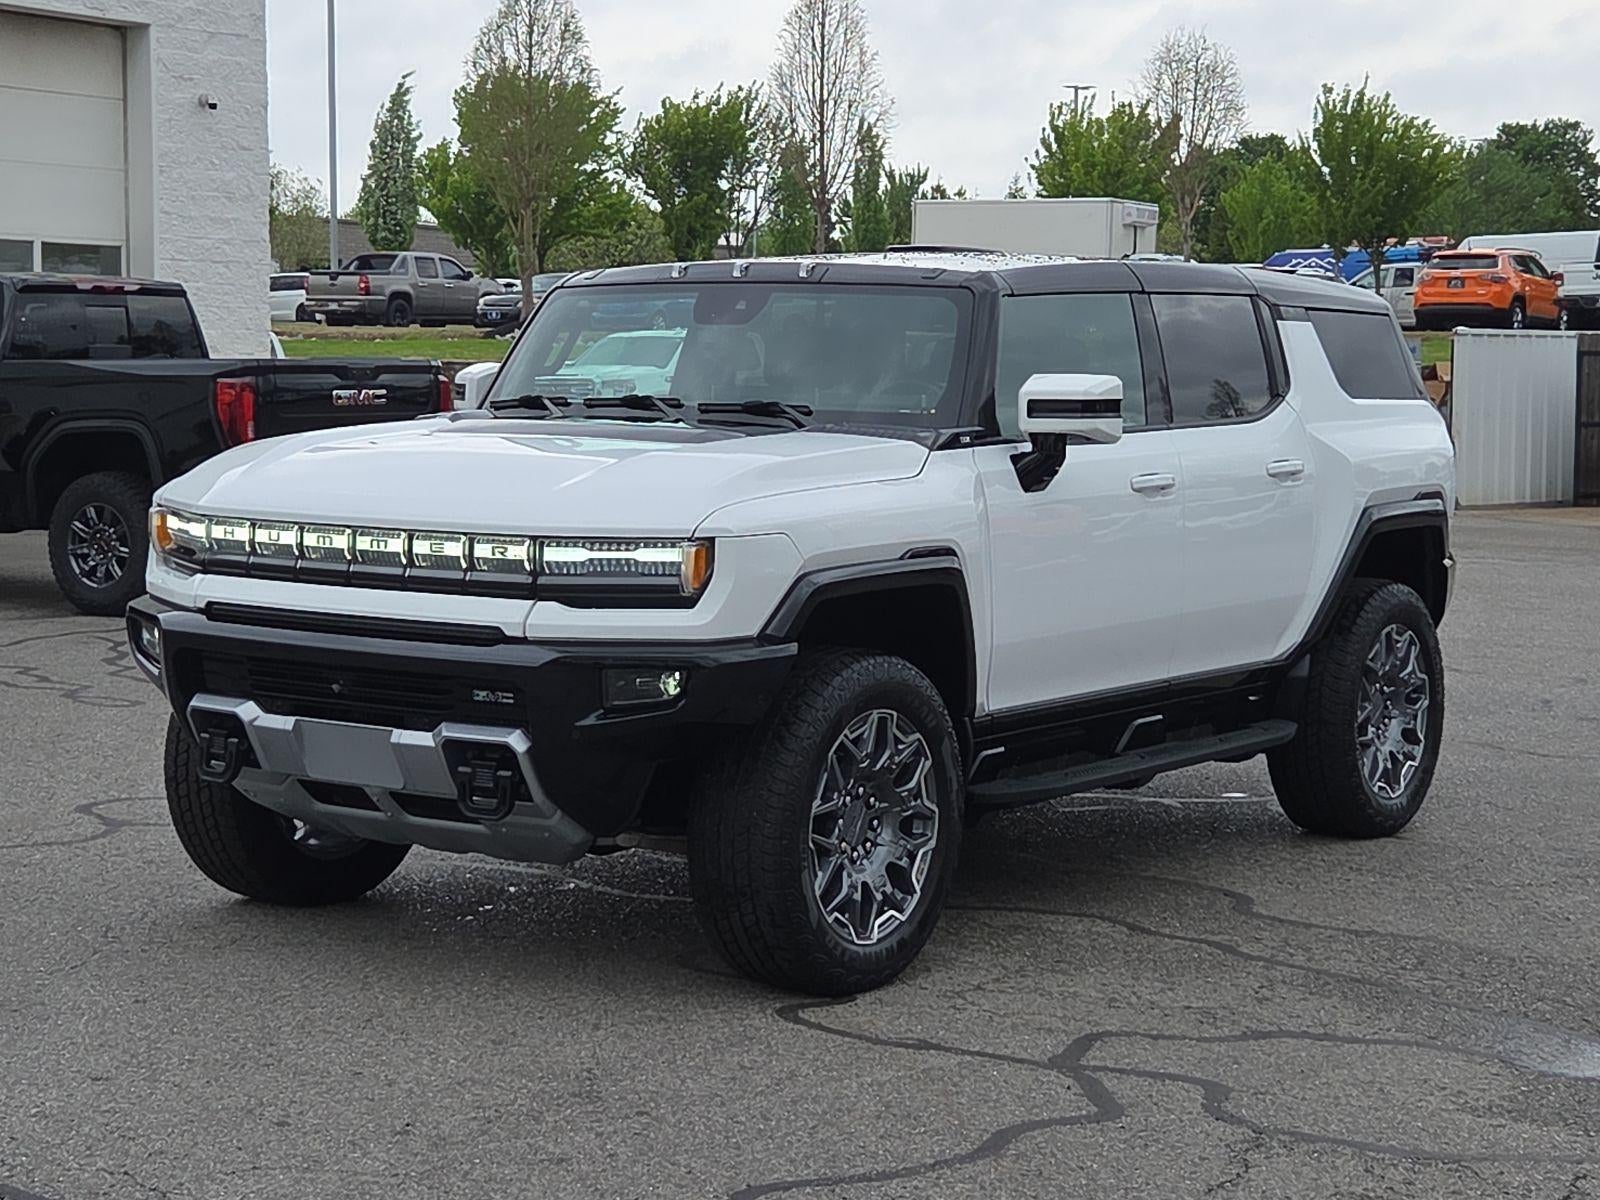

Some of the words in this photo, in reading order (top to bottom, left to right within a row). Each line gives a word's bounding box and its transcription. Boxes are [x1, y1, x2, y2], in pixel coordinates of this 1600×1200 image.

[332, 389, 387, 406] GMC
[223, 527, 507, 557] HUMMER
[472, 689, 514, 703] GMC
